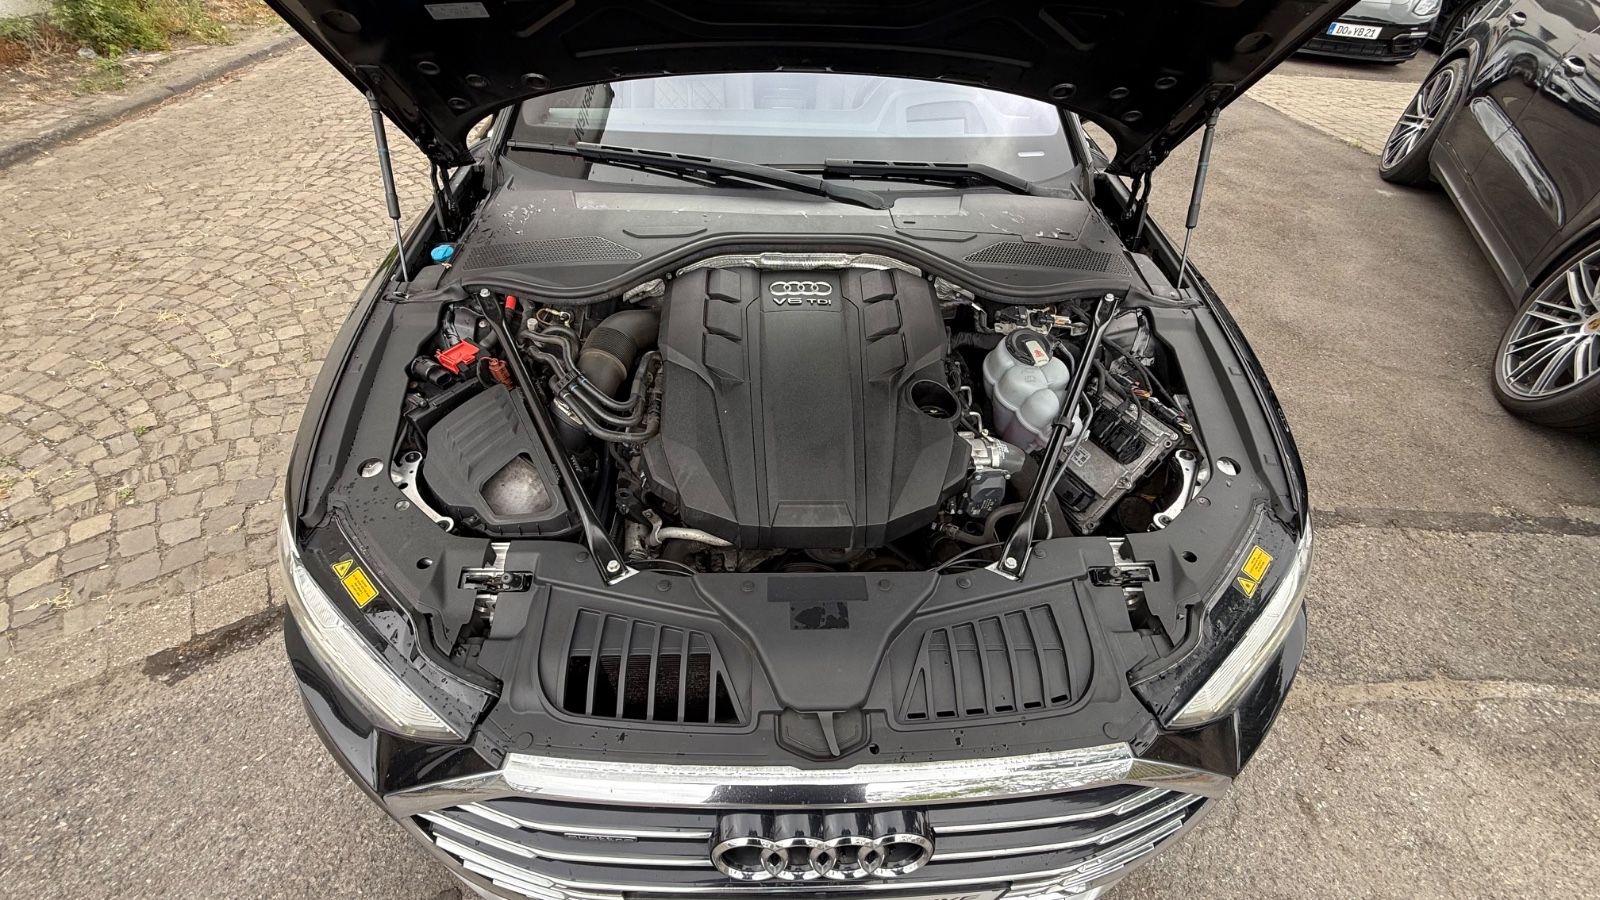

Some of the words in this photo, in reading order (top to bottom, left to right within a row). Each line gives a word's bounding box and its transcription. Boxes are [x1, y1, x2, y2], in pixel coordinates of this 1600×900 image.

[1336, 25, 1349, 35] DO
[773, 297, 802, 306] V6
[806, 298, 832, 307] TDI
